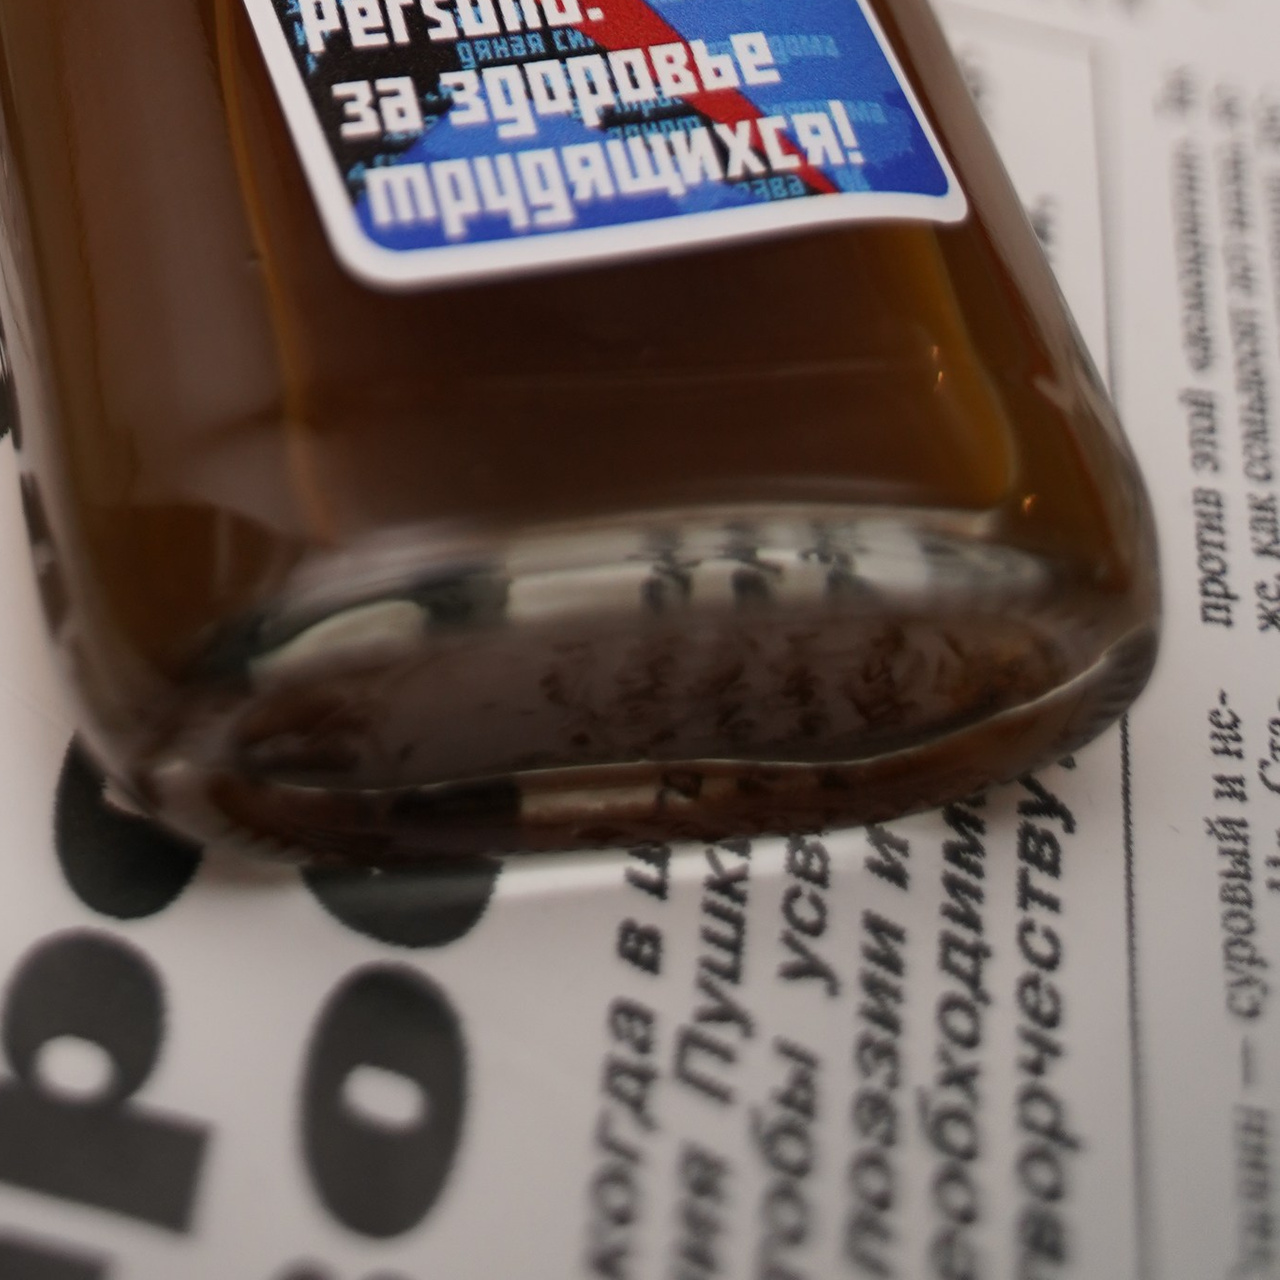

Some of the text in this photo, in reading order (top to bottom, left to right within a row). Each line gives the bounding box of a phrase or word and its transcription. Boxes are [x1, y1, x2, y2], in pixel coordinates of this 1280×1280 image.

[331, 31, 781, 140] за здоровье
[363, 98, 865, 237] трудящихся!
[1191, 485, 1239, 629] против
[1211, 773, 1249, 803] и
[617, 917, 665, 976] в
[1204, 815, 1268, 1020] суровый
[842, 908, 910, 1280] поэзии
